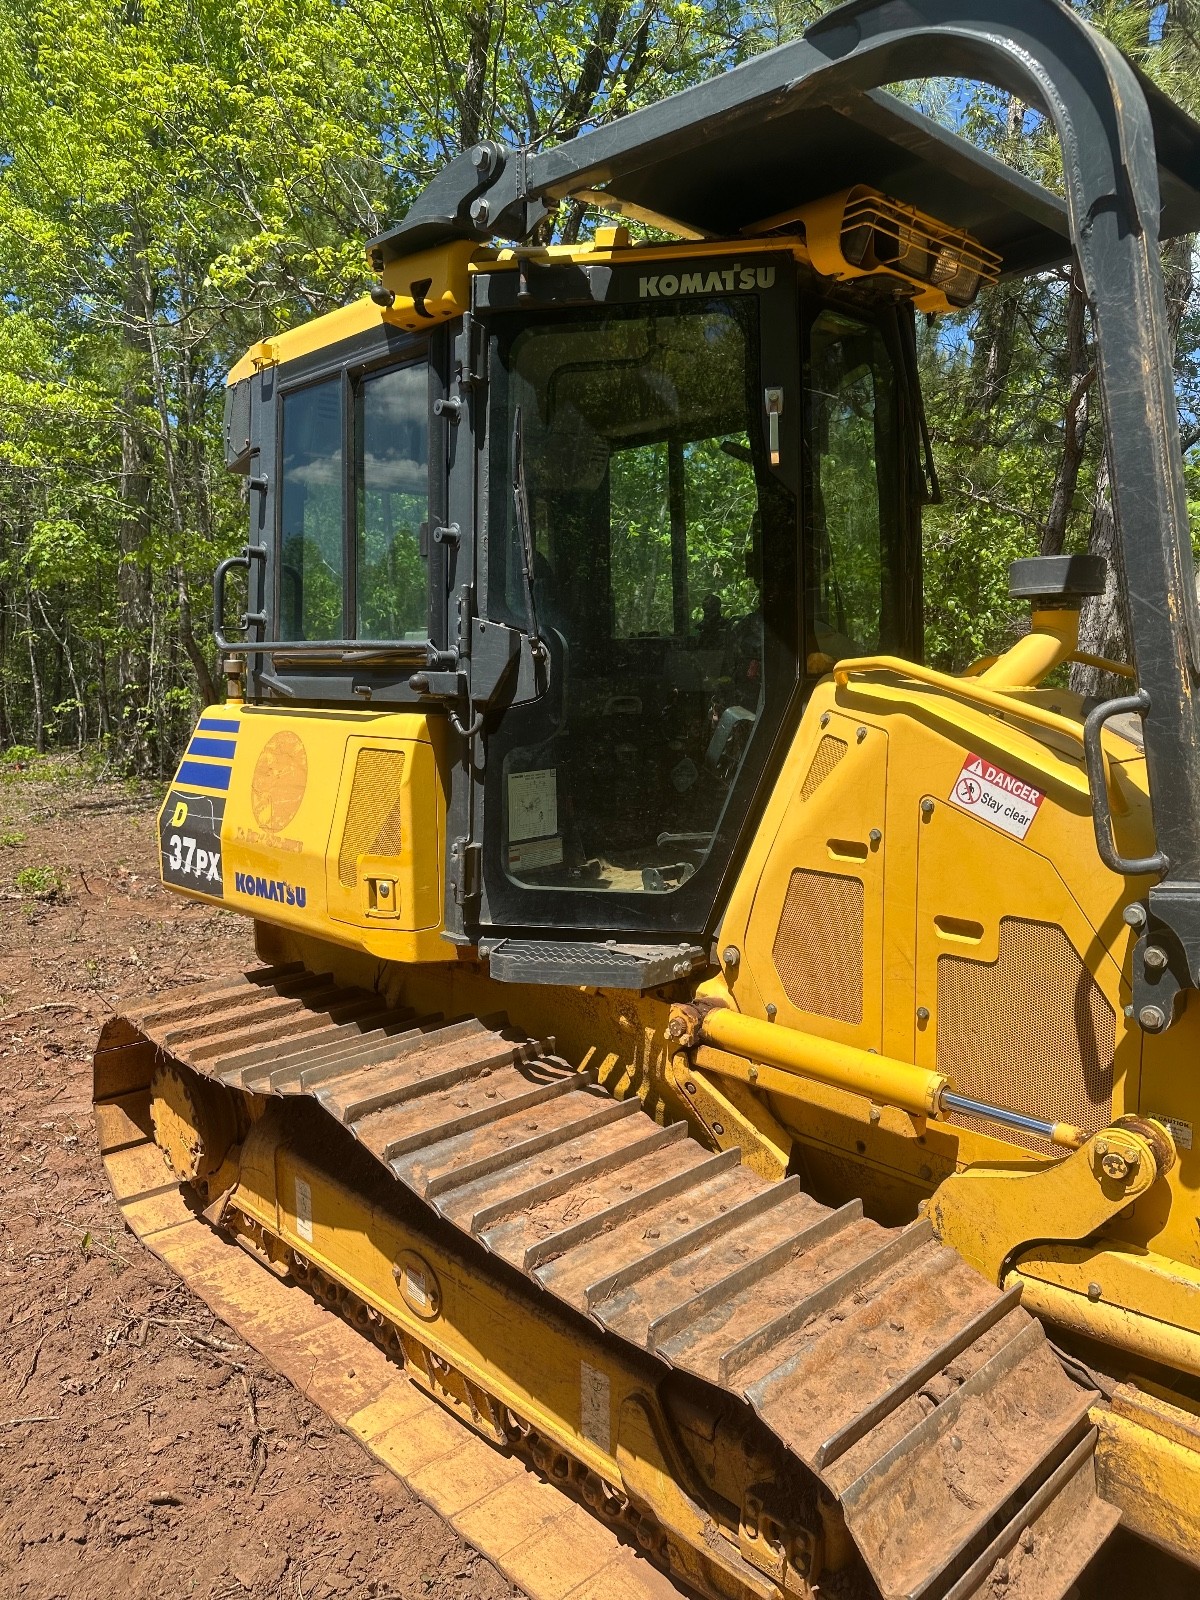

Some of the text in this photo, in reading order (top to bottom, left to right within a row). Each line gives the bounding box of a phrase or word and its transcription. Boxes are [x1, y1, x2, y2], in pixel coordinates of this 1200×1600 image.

[639, 263, 776, 298] KOMATSU
[985, 767, 1039, 804] DANGER
[171, 801, 189, 828] D
[980, 792, 1031, 826] Stay clear
[169, 834, 222, 881] 37PX
[235, 871, 306, 908] KOMATSU
[1158, 1117, 1189, 1128] CAUTION
